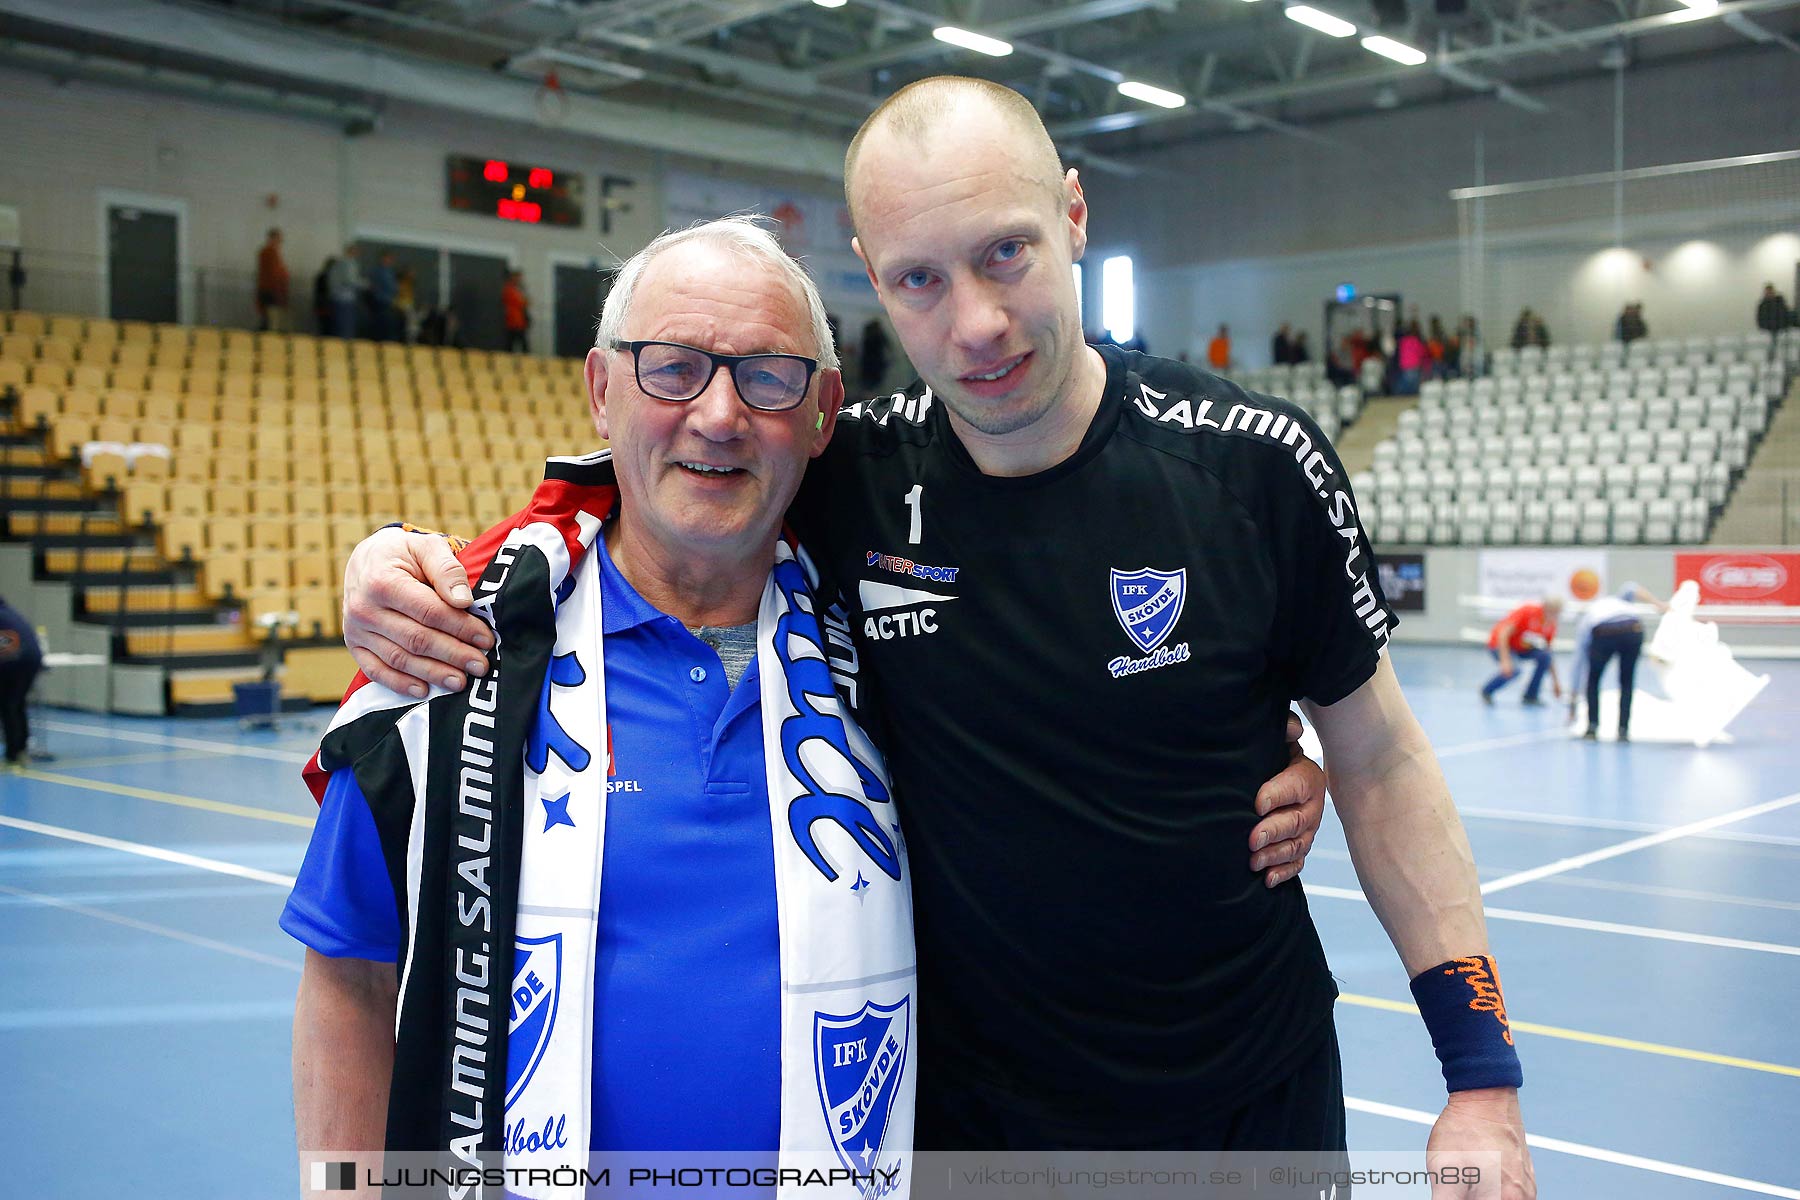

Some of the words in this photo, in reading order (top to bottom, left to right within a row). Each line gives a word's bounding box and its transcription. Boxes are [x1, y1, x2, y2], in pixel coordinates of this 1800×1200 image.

[904, 484, 923, 544] 1
[866, 550, 959, 583] INTERSPORT
[1122, 584, 1149, 596] IFK
[1127, 587, 1175, 623] SKÖVDE
[864, 608, 939, 641] ACTIC
[1108, 642, 1191, 679] Handboll
[605, 780, 643, 794] SPEL
[833, 1037, 867, 1068] IFK
[839, 1034, 899, 1135] SKÖVDE
